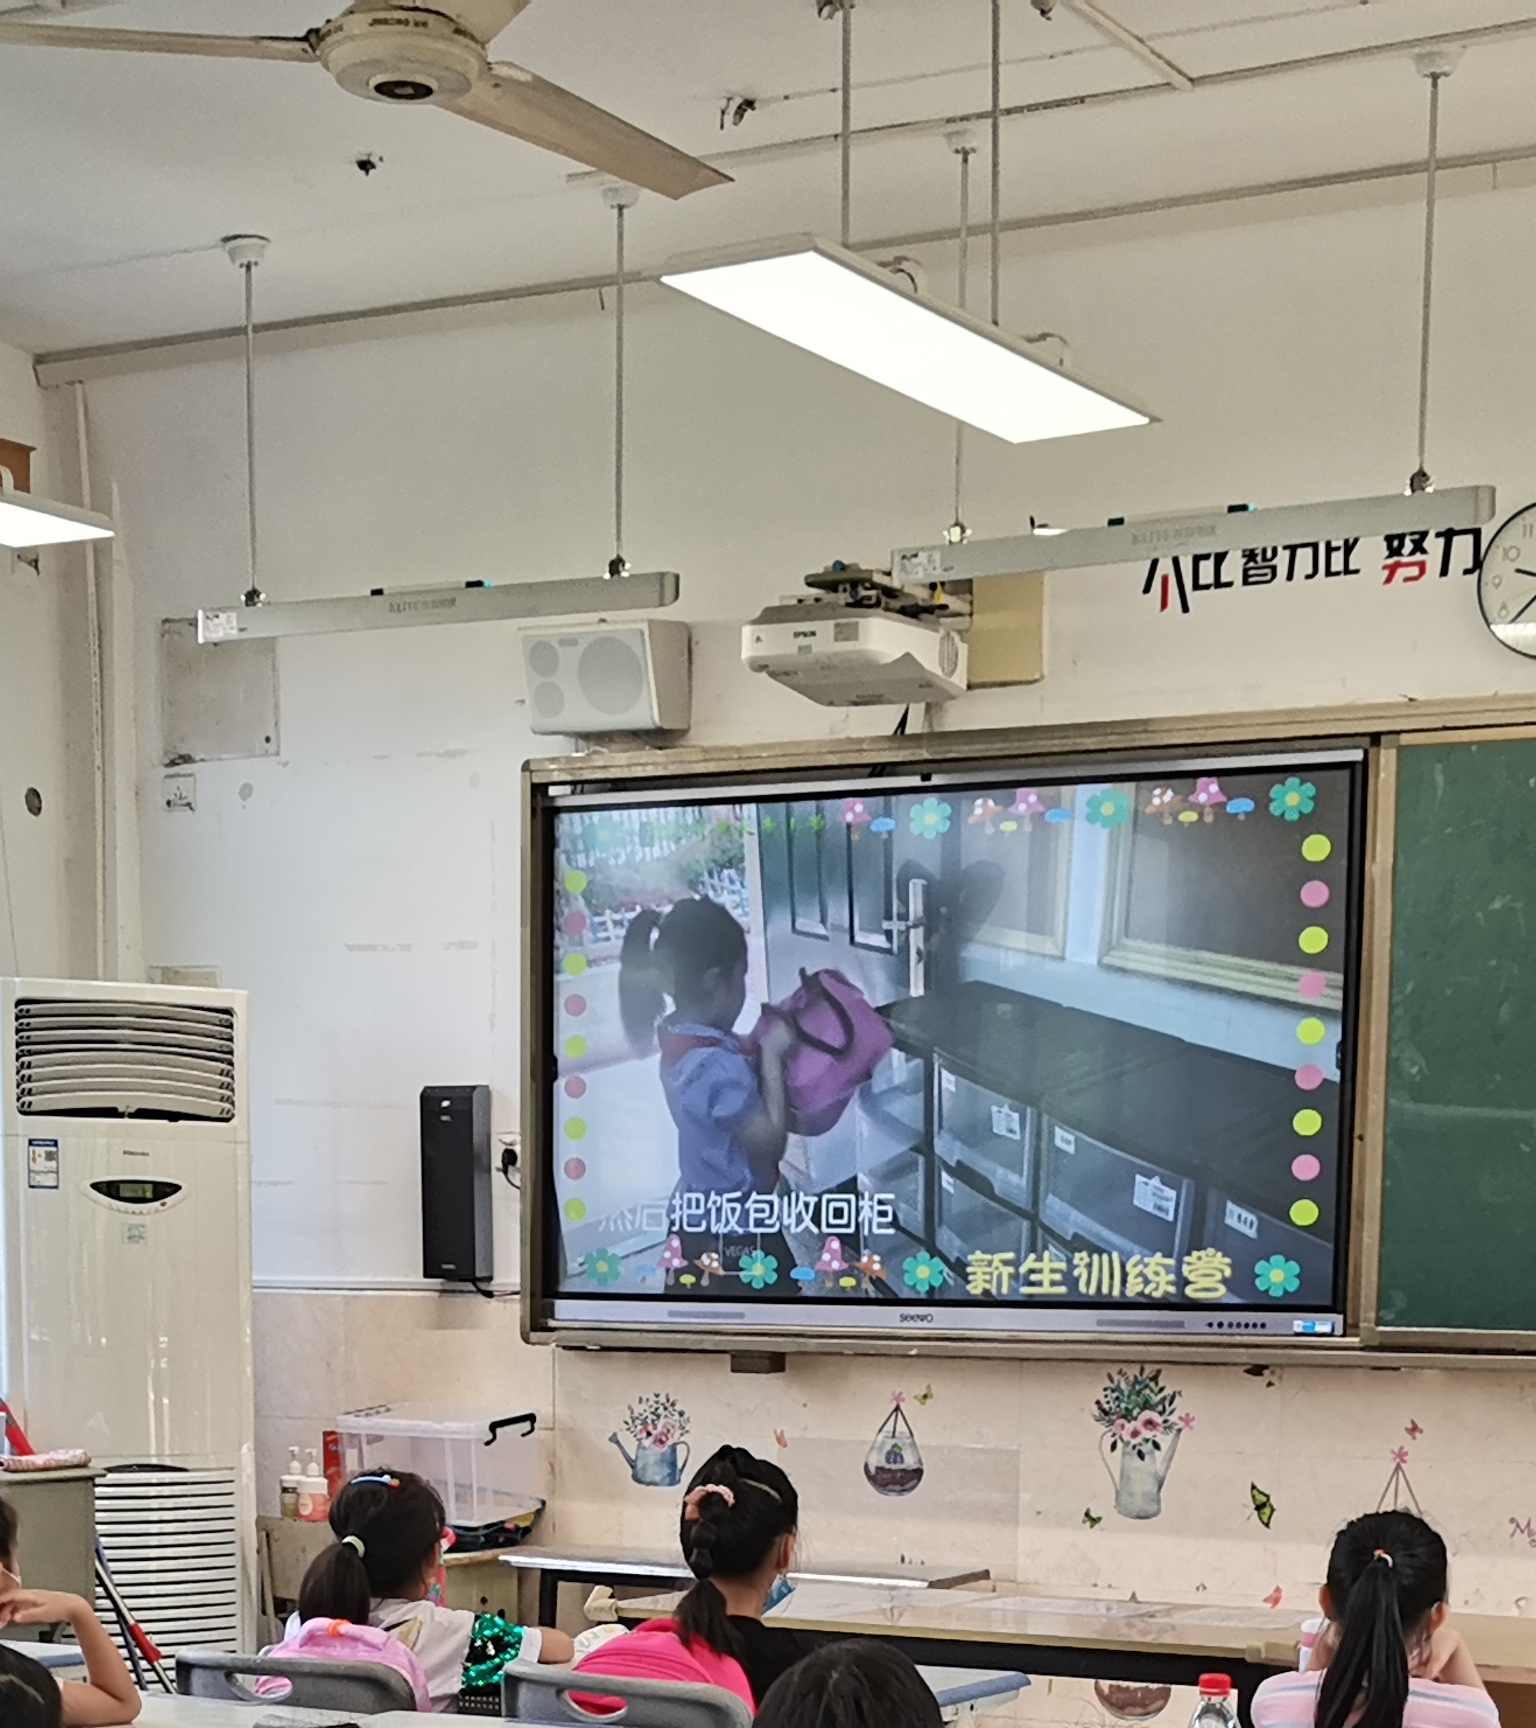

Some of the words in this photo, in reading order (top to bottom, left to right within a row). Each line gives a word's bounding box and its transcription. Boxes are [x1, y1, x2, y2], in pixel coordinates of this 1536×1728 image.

[965, 1247, 1233, 1300] 新生训练营
